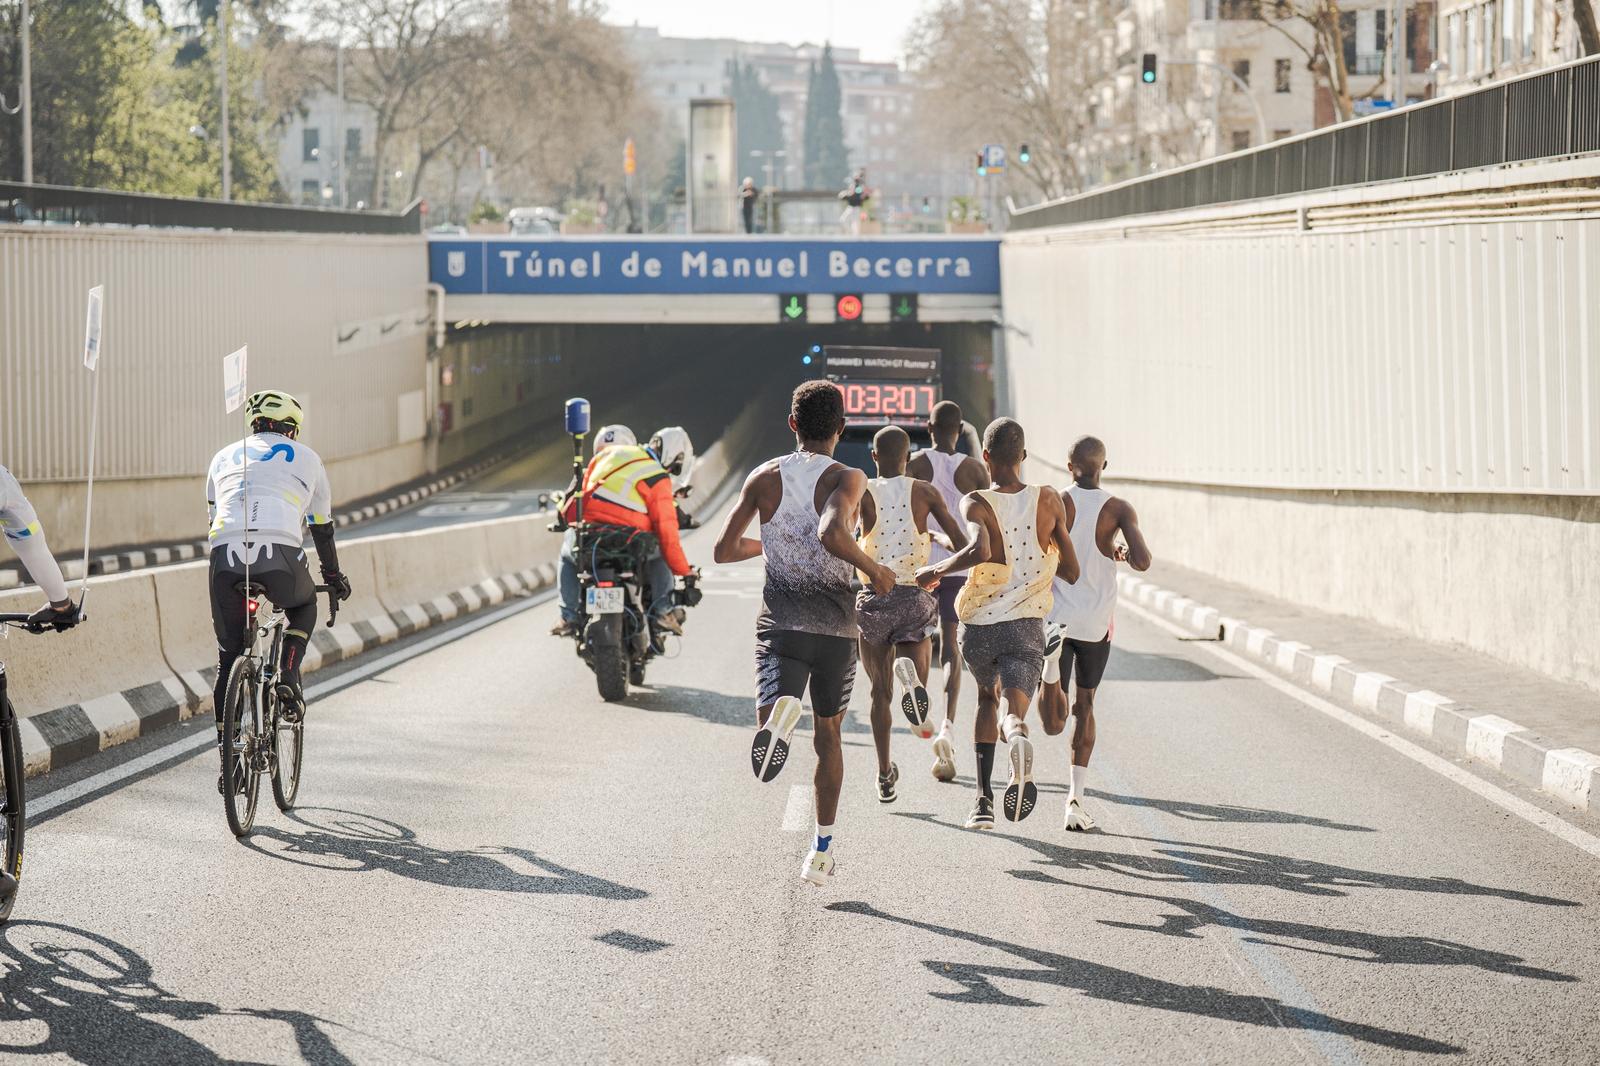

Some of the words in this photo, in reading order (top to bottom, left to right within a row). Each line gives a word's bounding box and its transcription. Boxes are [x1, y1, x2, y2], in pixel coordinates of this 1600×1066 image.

[499, 250, 600, 278] Túnel
[620, 250, 662, 278] de
[681, 250, 808, 278] Manuel
[829, 250, 972, 278] Becerra
